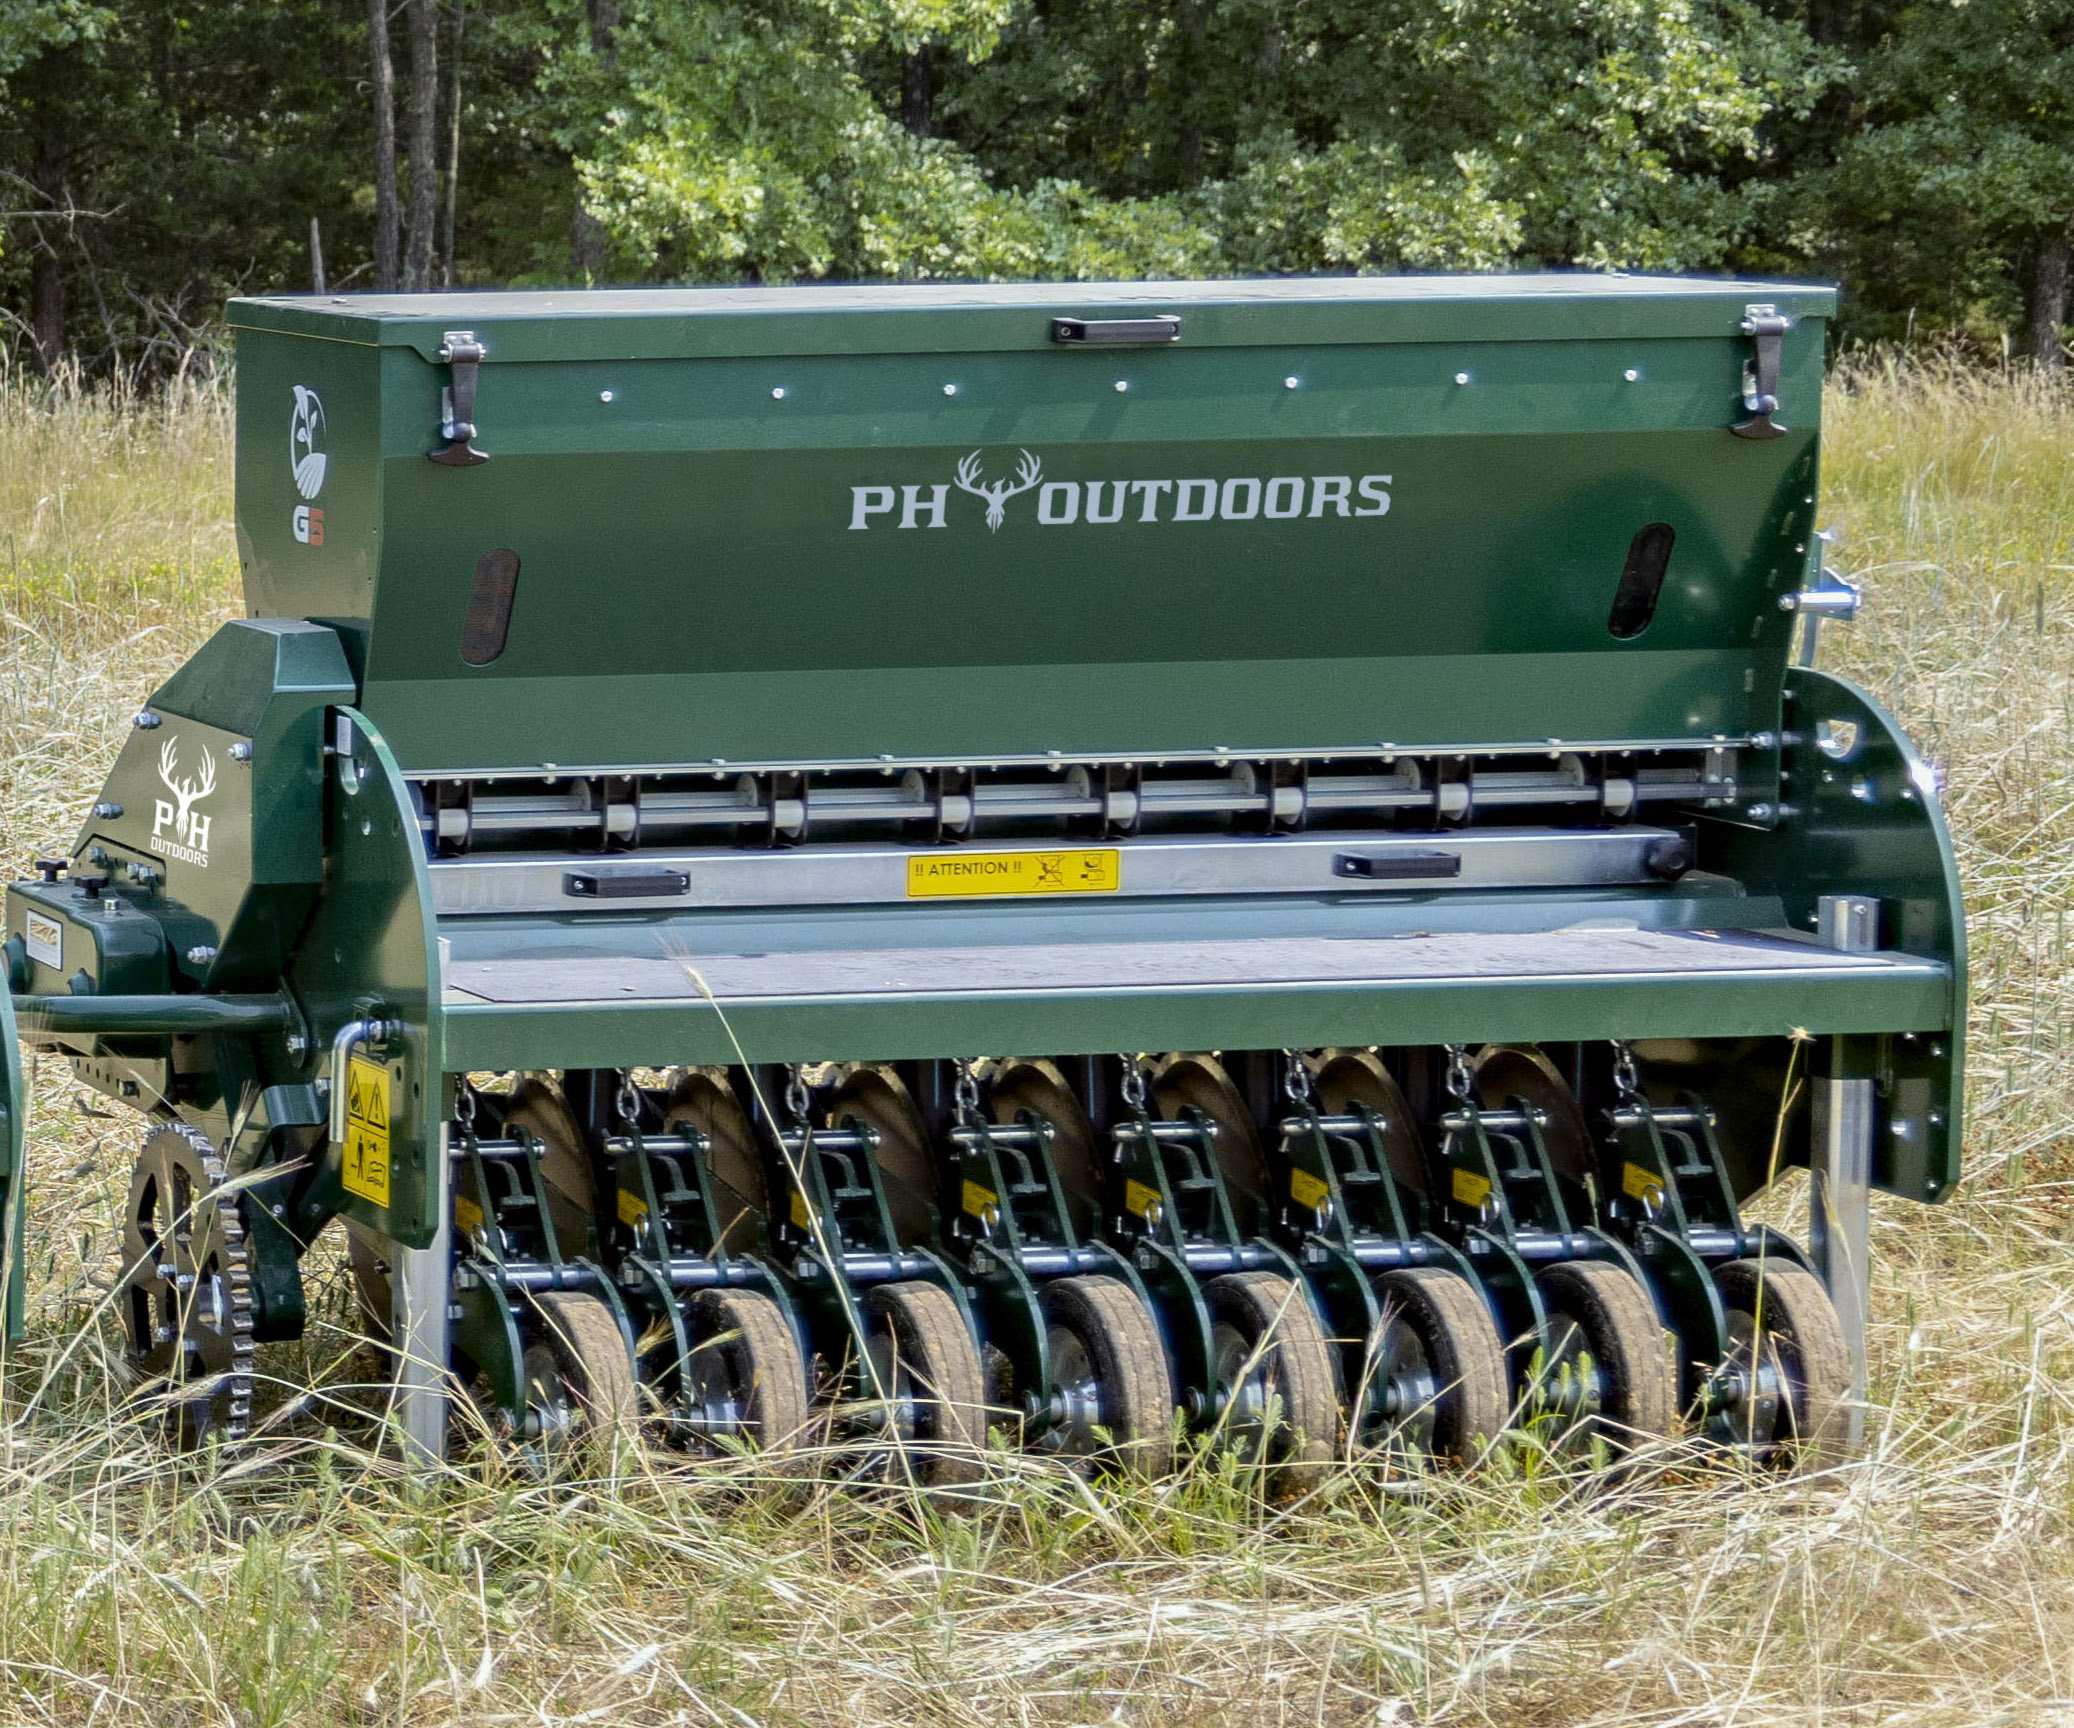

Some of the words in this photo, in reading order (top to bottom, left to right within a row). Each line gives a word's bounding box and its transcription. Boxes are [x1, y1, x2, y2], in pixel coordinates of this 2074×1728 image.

[847, 483, 951, 530] PH
[1037, 475, 1393, 525] OUTDOORS
[150, 836, 209, 868] OUTDOORS
[928, 861, 1008, 876] ATTENTION
